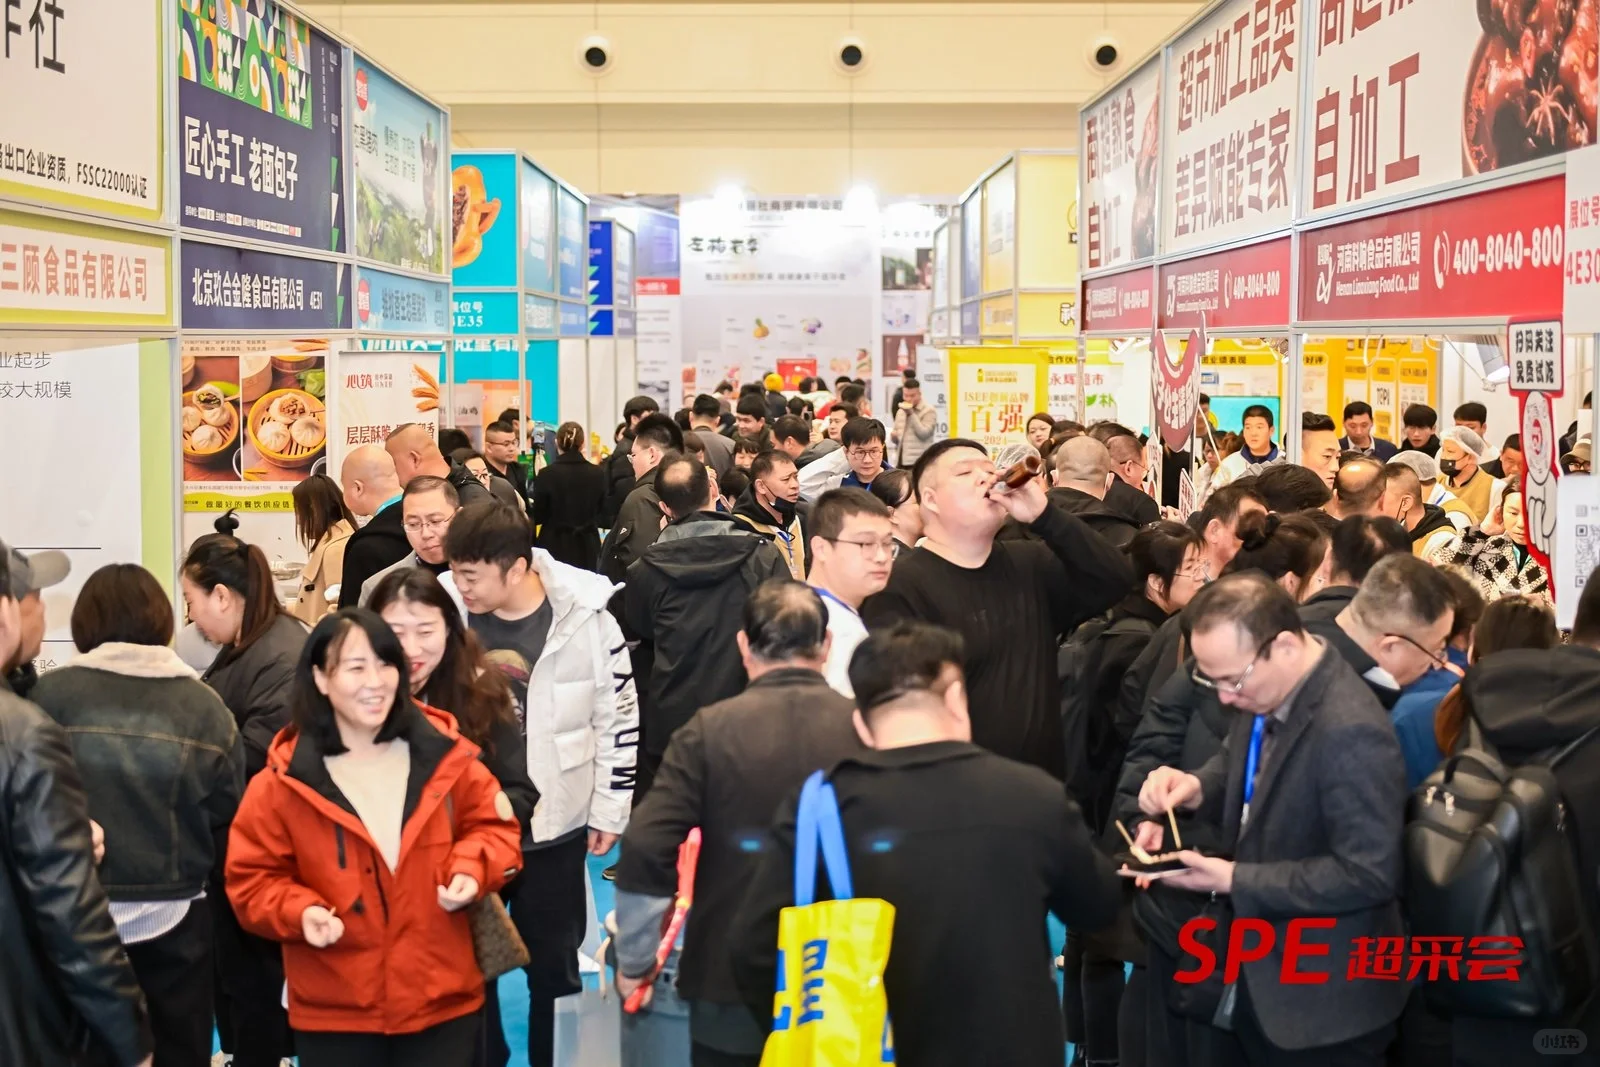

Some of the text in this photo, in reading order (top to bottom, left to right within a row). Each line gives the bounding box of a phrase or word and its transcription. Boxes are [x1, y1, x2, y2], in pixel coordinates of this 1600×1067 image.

[1177, 0, 1297, 136] 超市加工品类
[185, 115, 299, 201] 匠心手工 老面包子
[1313, 52, 1420, 210] 自加工
[0, 143, 148, 199] 出口企业资质，FSSC22000认证
[1174, 107, 1291, 238] 差异赋能专家
[1569, 195, 1600, 230] 展位号
[1, 243, 148, 302] 三顾食品有限公司
[1453, 224, 1564, 276] 400-8040-800
[1233, 270, 1281, 300] 400-8040-800
[1379, 273, 1396, 293] Food
[970, 404, 1025, 433] 百强
